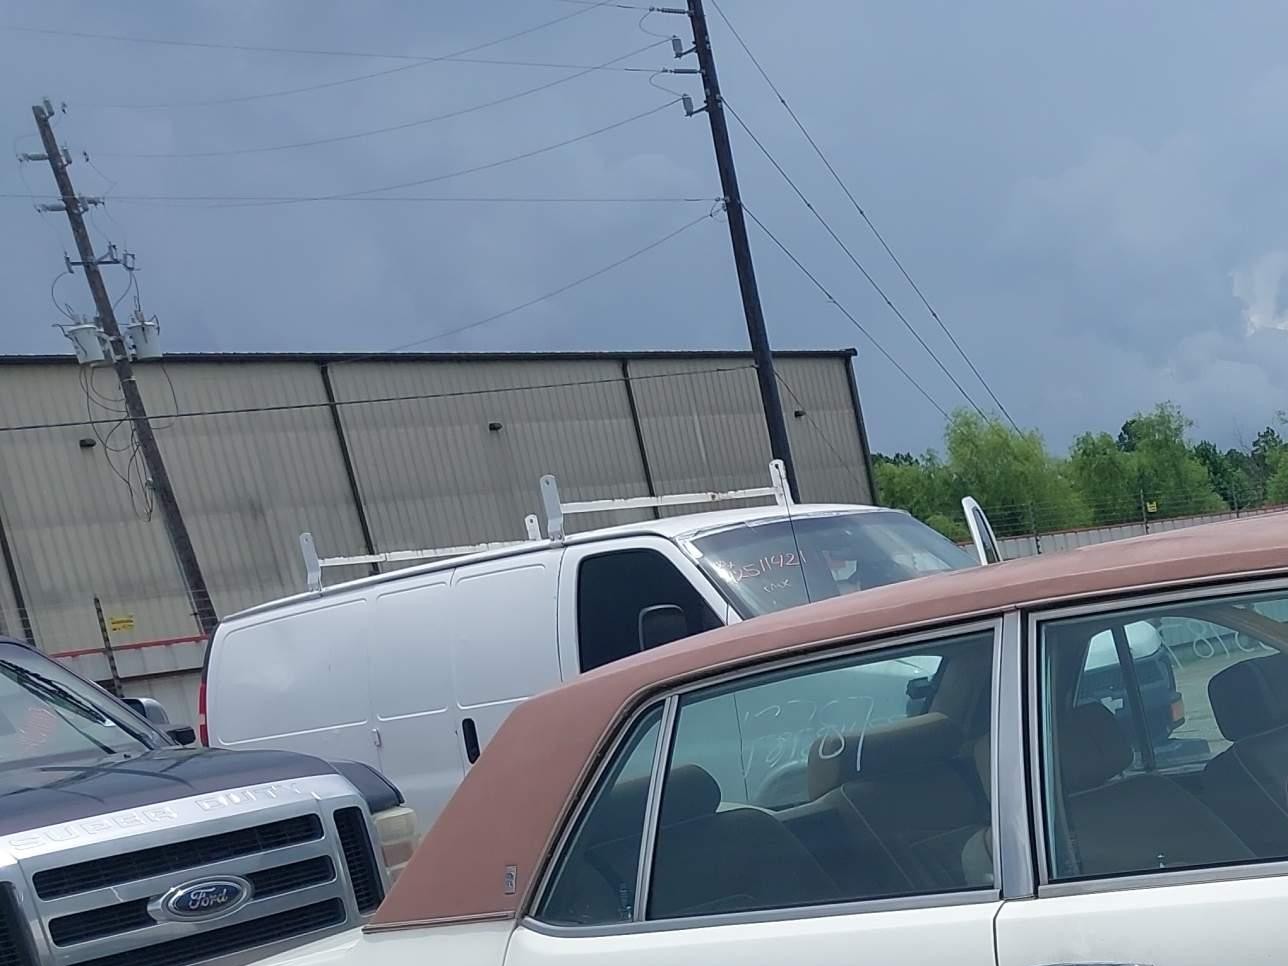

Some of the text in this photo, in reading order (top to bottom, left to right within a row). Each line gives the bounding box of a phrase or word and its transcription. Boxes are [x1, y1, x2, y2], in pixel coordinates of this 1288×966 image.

[8, 783, 304, 851] SUPER DUTY
[188, 887, 229, 909] Ford
